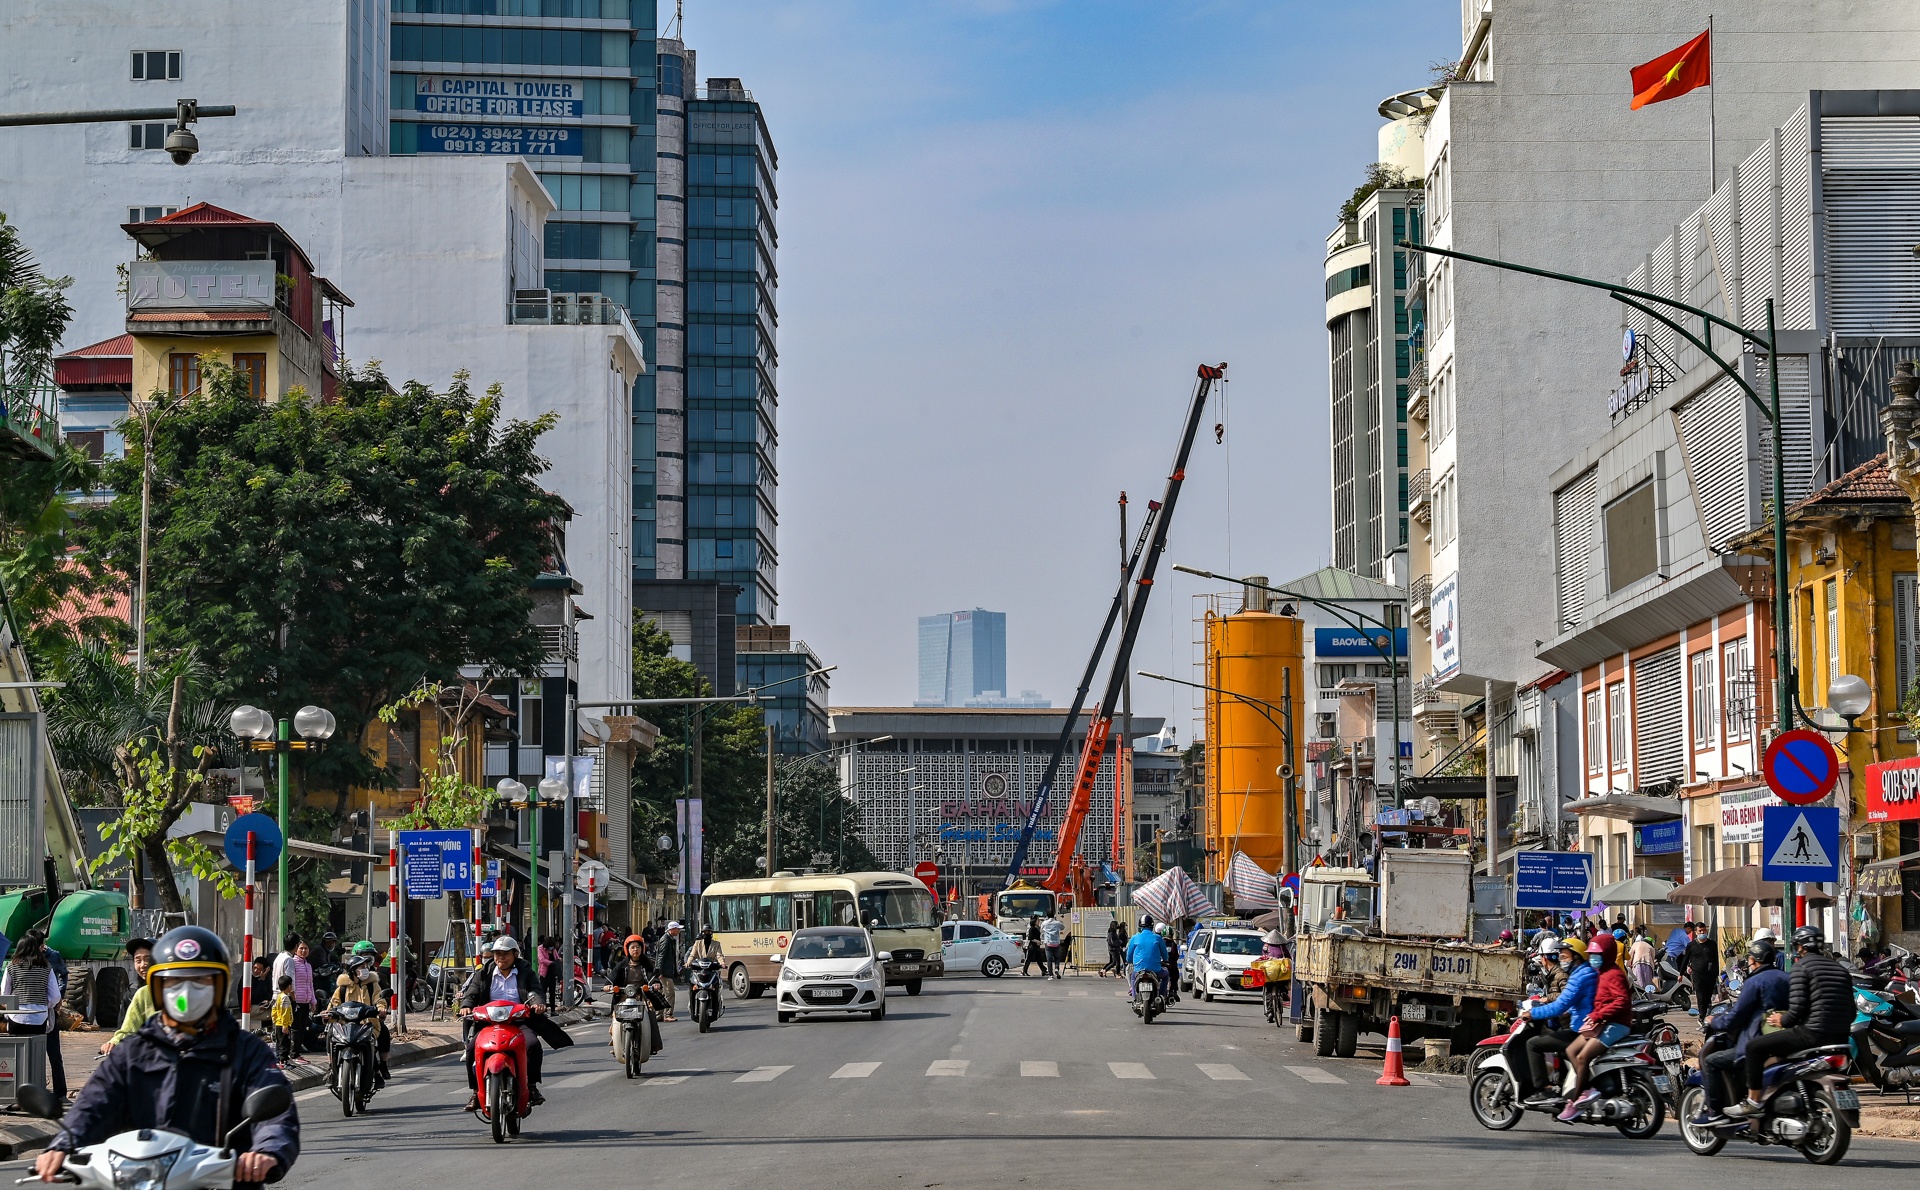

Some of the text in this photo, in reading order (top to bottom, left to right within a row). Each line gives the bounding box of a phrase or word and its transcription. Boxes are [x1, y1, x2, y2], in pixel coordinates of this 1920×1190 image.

[442, 79, 573, 98] CAPITAL TOWER
[426, 97, 573, 116] OFFICE FOR LEASE
[431, 126, 569, 141] (024) 3942 7979
[444, 140, 556, 154] 0913 281 771
[134, 275, 270, 299] HOTEL
[1882, 768, 1920, 802] 90B SP
[940, 801, 974, 818] GA
[1740, 804, 1757, 828] BỆNH
[938, 823, 988, 841] Hanoi
[460, 862, 468, 879] 5
[1393, 953, 1471, 974] 29H 031.01
